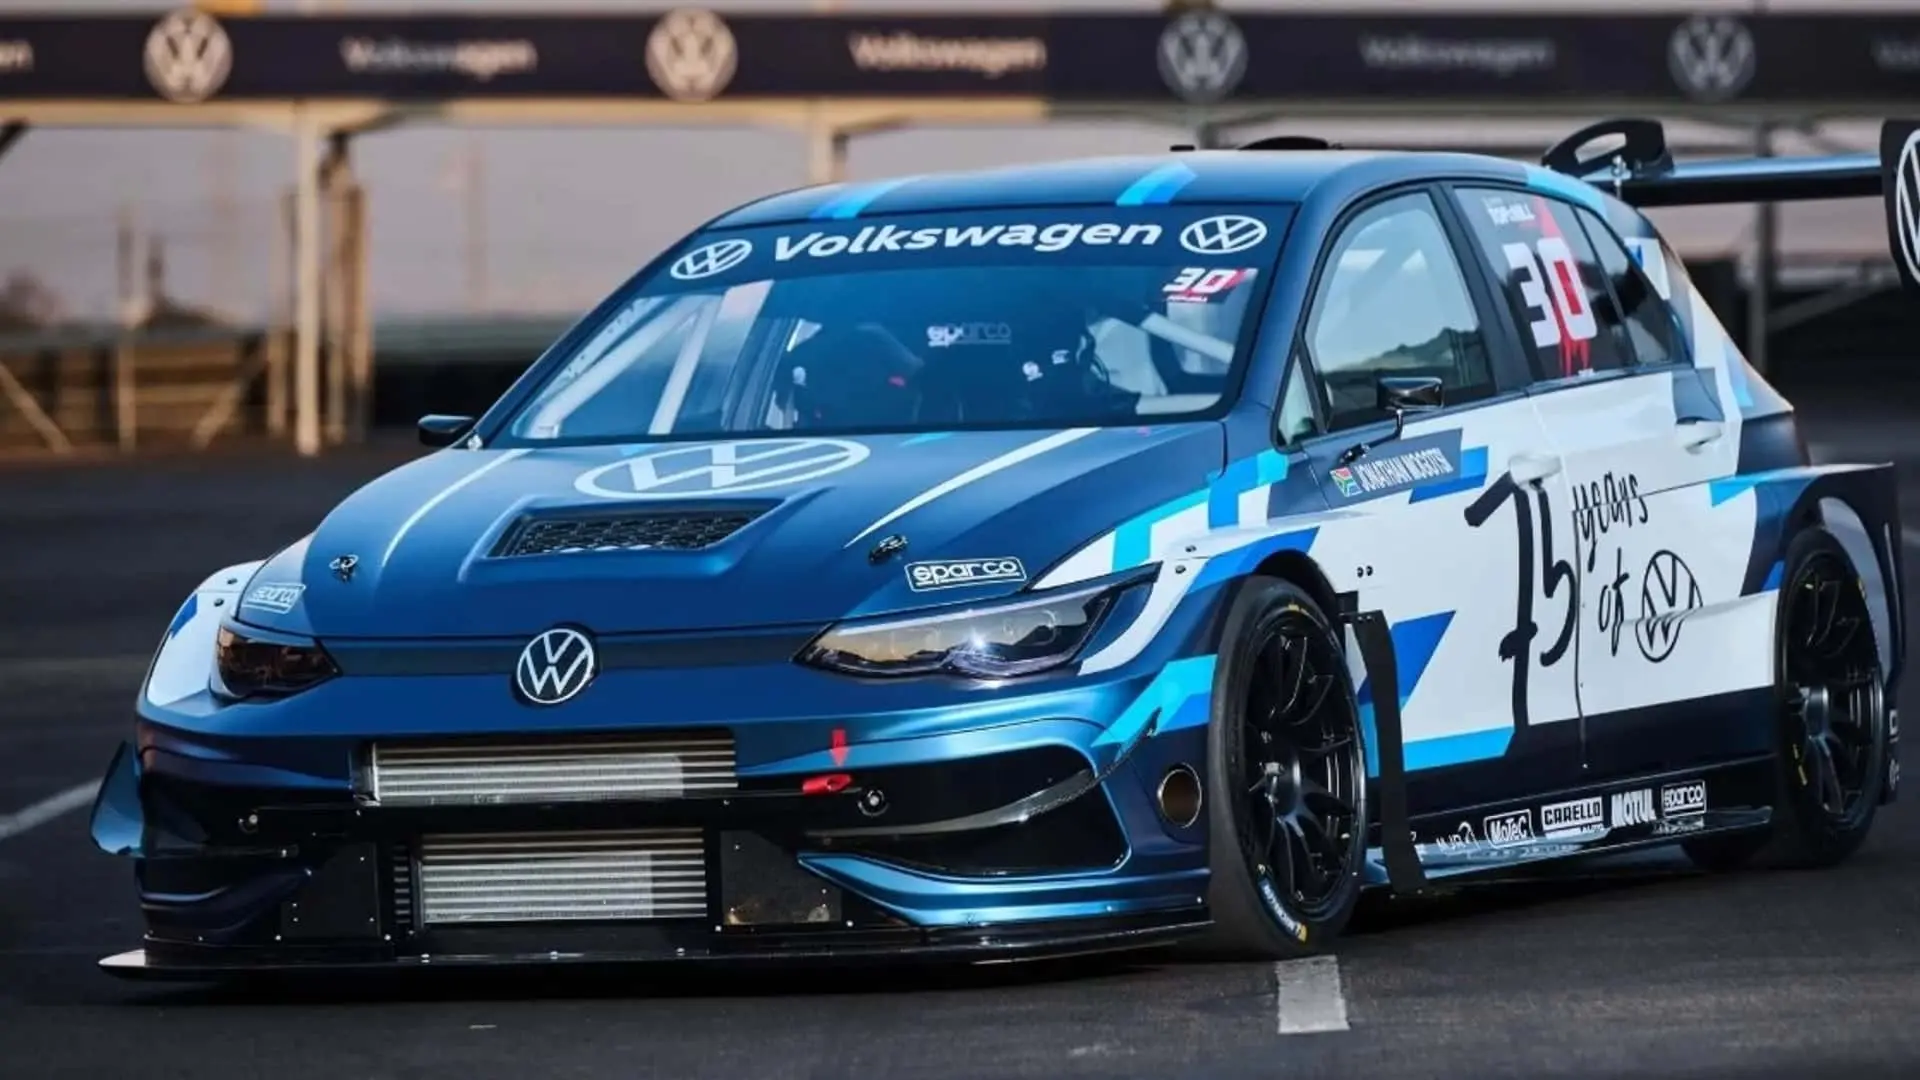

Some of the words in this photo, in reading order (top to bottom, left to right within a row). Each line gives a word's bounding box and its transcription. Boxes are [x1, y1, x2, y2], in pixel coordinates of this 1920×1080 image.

[775, 218, 1163, 262] Volkswagen
[1162, 267, 1236, 293] 30
[1502, 238, 1597, 348] 30
[1573, 471, 1648, 573] years
[914, 561, 1020, 586] sparco
[1600, 547, 1629, 656] of
[1545, 801, 1601, 825] CARELLO
[1612, 789, 1656, 828] MOTUL
[1664, 785, 1703, 809] sparco
[1490, 816, 1528, 843] MoTeC
